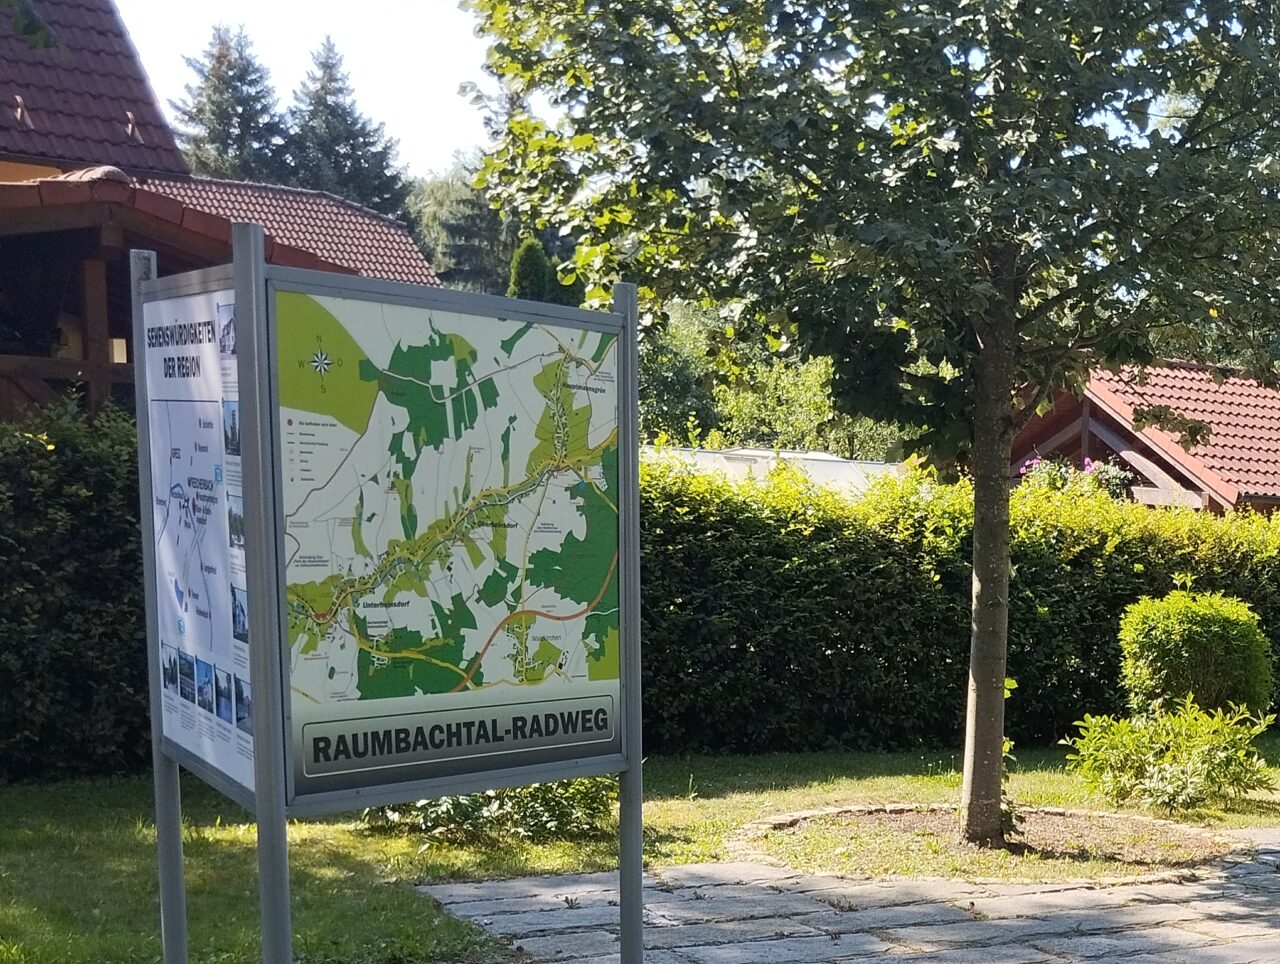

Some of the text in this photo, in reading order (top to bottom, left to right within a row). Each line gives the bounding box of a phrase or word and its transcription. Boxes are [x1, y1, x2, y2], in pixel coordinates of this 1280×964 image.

[147, 318, 217, 349] SEHENSWÜRDIGKEITEN
[316, 335, 322, 343] N
[163, 355, 201, 378] DER REGION
[297, 360, 305, 368] W
[320, 384, 326, 394] S
[312, 707, 609, 763] RAUMBACHTAL-RADWEG
